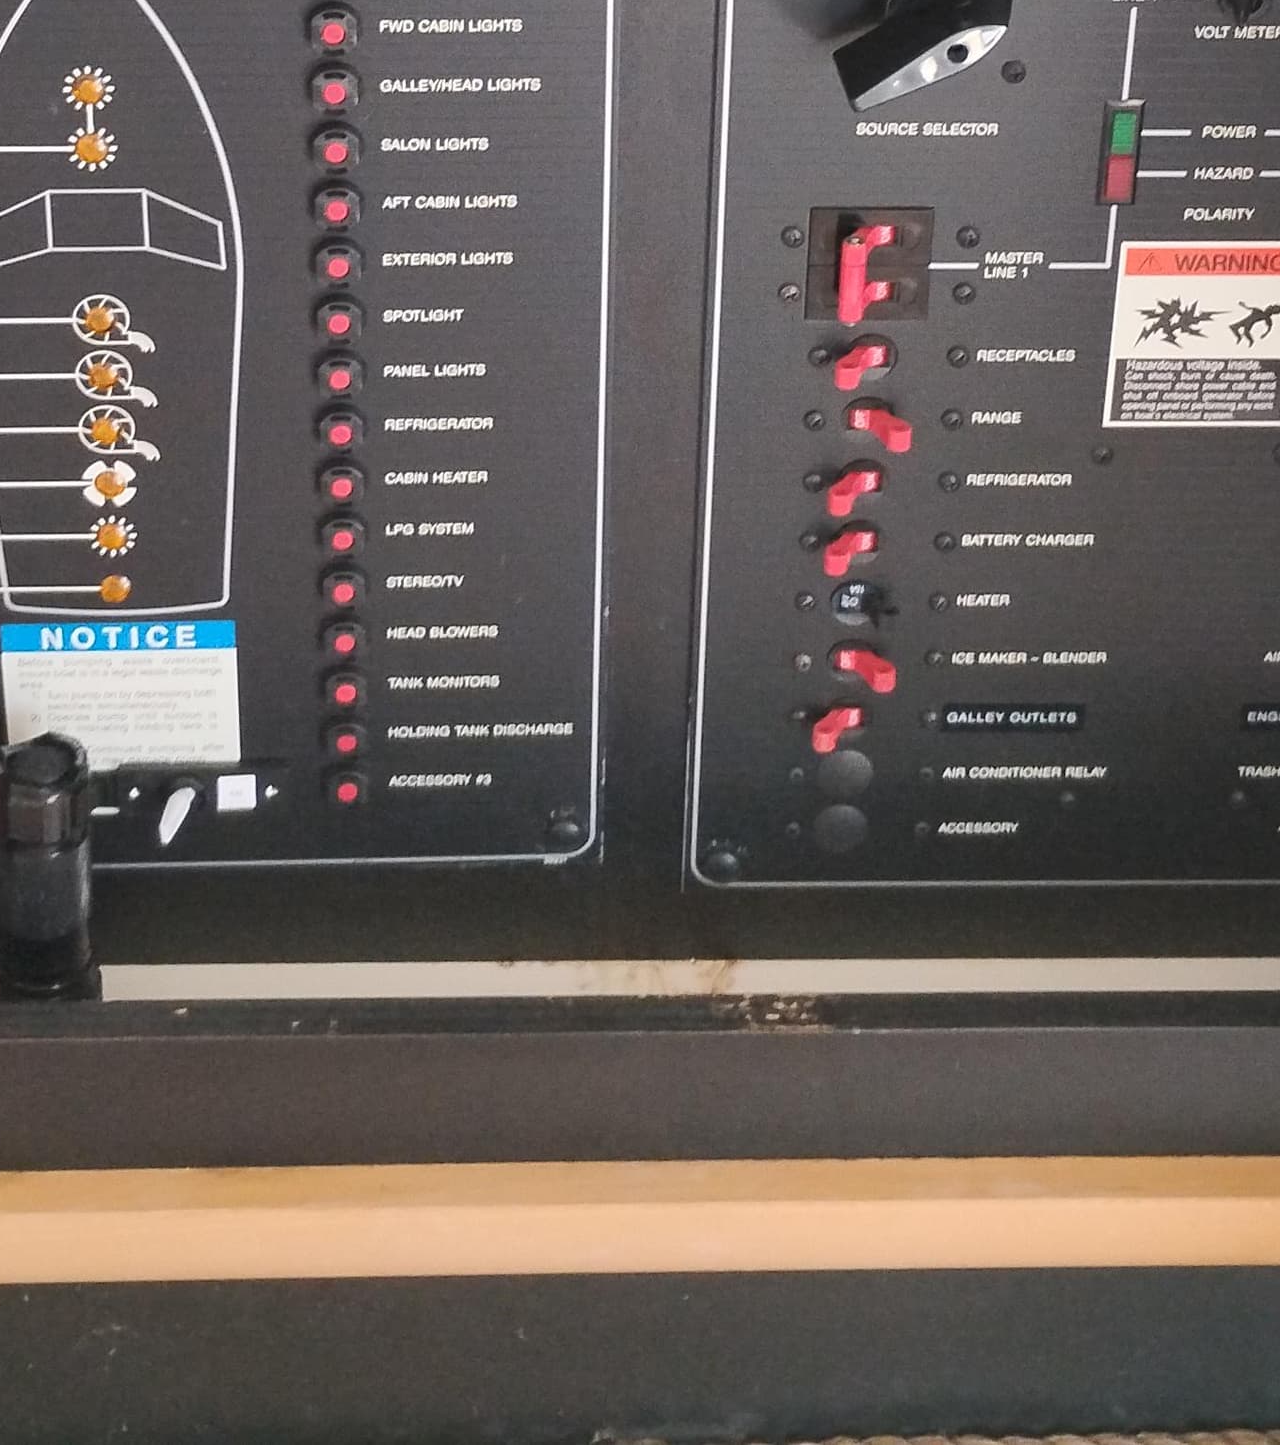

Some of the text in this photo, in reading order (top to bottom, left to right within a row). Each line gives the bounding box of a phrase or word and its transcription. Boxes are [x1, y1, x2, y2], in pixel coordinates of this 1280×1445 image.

[380, 19, 522, 33] FWD CABIN LIGHTS
[1195, 26, 1231, 38] VOLT
[380, 78, 541, 92] GALLEY/HEAD LIGHTS
[856, 123, 998, 135] SOURCE SELECTOR
[1202, 126, 1256, 138] POWER
[381, 138, 489, 151] SALON LIGHTS
[1194, 167, 1253, 179] HAZARD
[382, 195, 517, 209] AFT CABIN LIGHTS
[1184, 208, 1255, 221] POLARITY
[383, 252, 513, 266] EXTERIOR LIGHTS
[985, 252, 1043, 264] MASTER
[984, 266, 1016, 278] LINE
[383, 309, 464, 322] SPOTLIGHT
[977, 350, 1075, 361] RECEPTACLES
[384, 364, 486, 377] PANEL LIGHTS
[385, 417, 493, 431] REFRIGERATOR
[972, 412, 1021, 424] RANGE
[385, 471, 488, 484] CABIN HEATER
[967, 474, 1072, 486] REFRIGERATOR
[962, 534, 1094, 546] BATTERY CHARGER
[387, 575, 464, 588] STEREO/TV
[957, 594, 1010, 606] HEATER
[41, 625, 196, 650] NOTICE
[387, 625, 498, 639] HEAD BLOWERS
[947, 712, 1076, 723] GALLEY OUTLETS
